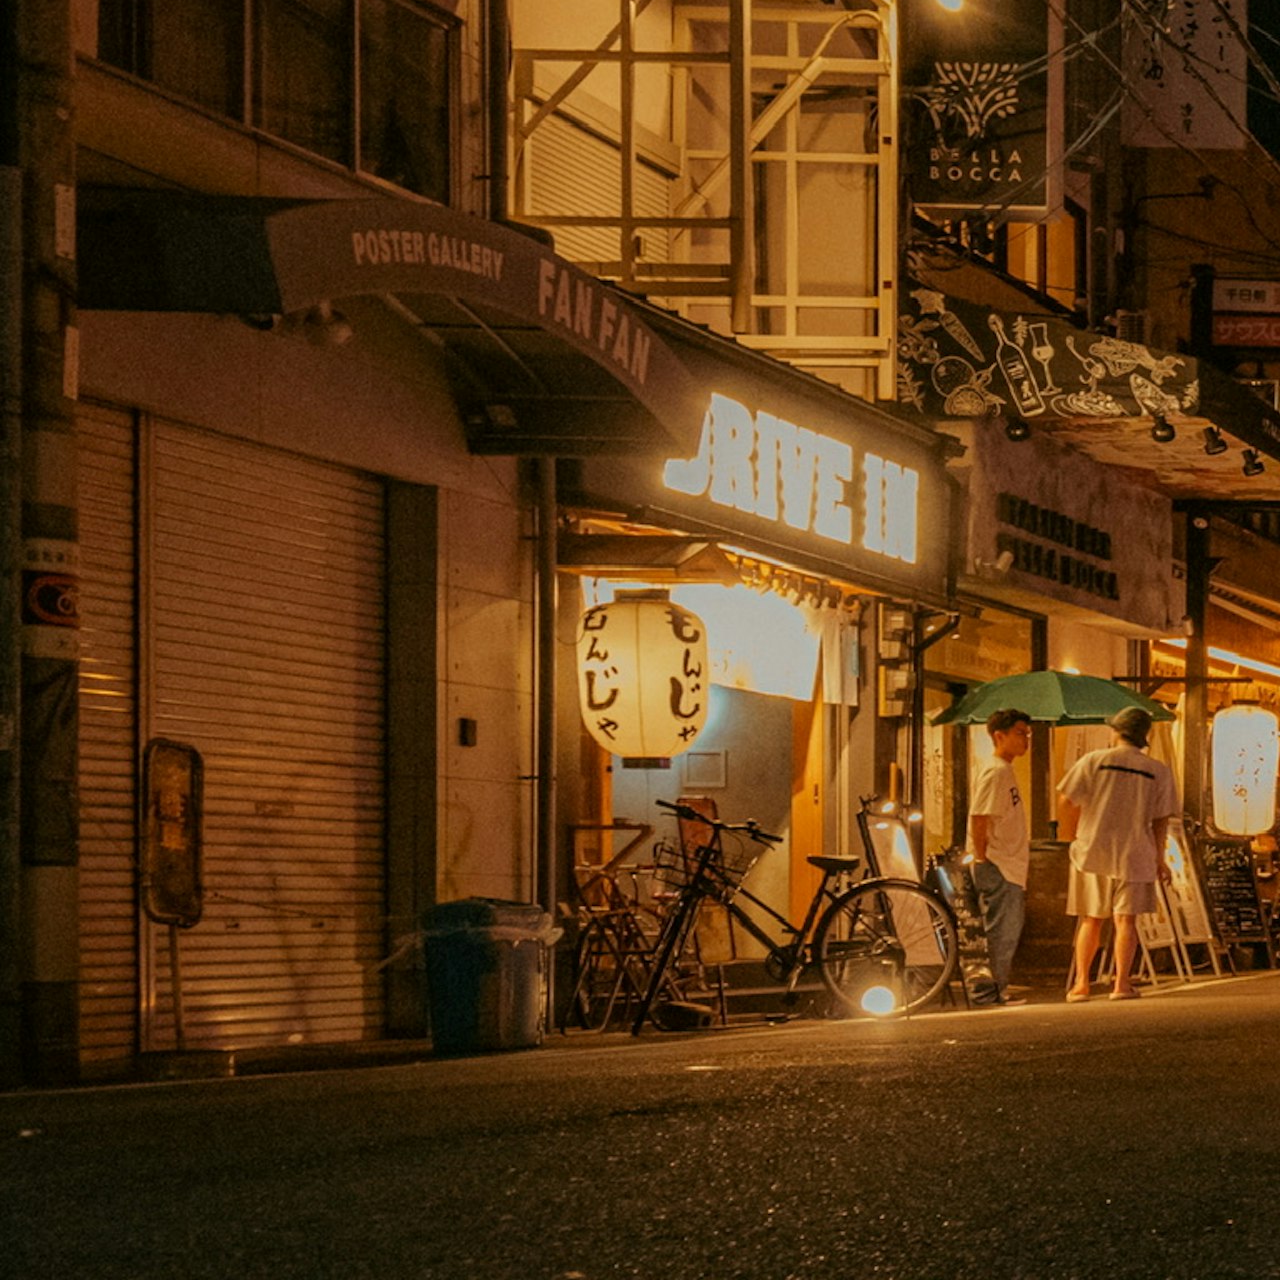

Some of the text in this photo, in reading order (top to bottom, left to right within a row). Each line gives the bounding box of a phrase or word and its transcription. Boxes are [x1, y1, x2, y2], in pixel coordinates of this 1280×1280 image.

[929, 147, 1022, 164] BELLA
[929, 165, 1022, 182] BOCCA
[352, 230, 504, 281] POSTER GALLERY
[538, 258, 651, 385] FAN FAN
[583, 604, 619, 741] もんじゃ
[665, 608, 701, 742] もんじゃ
